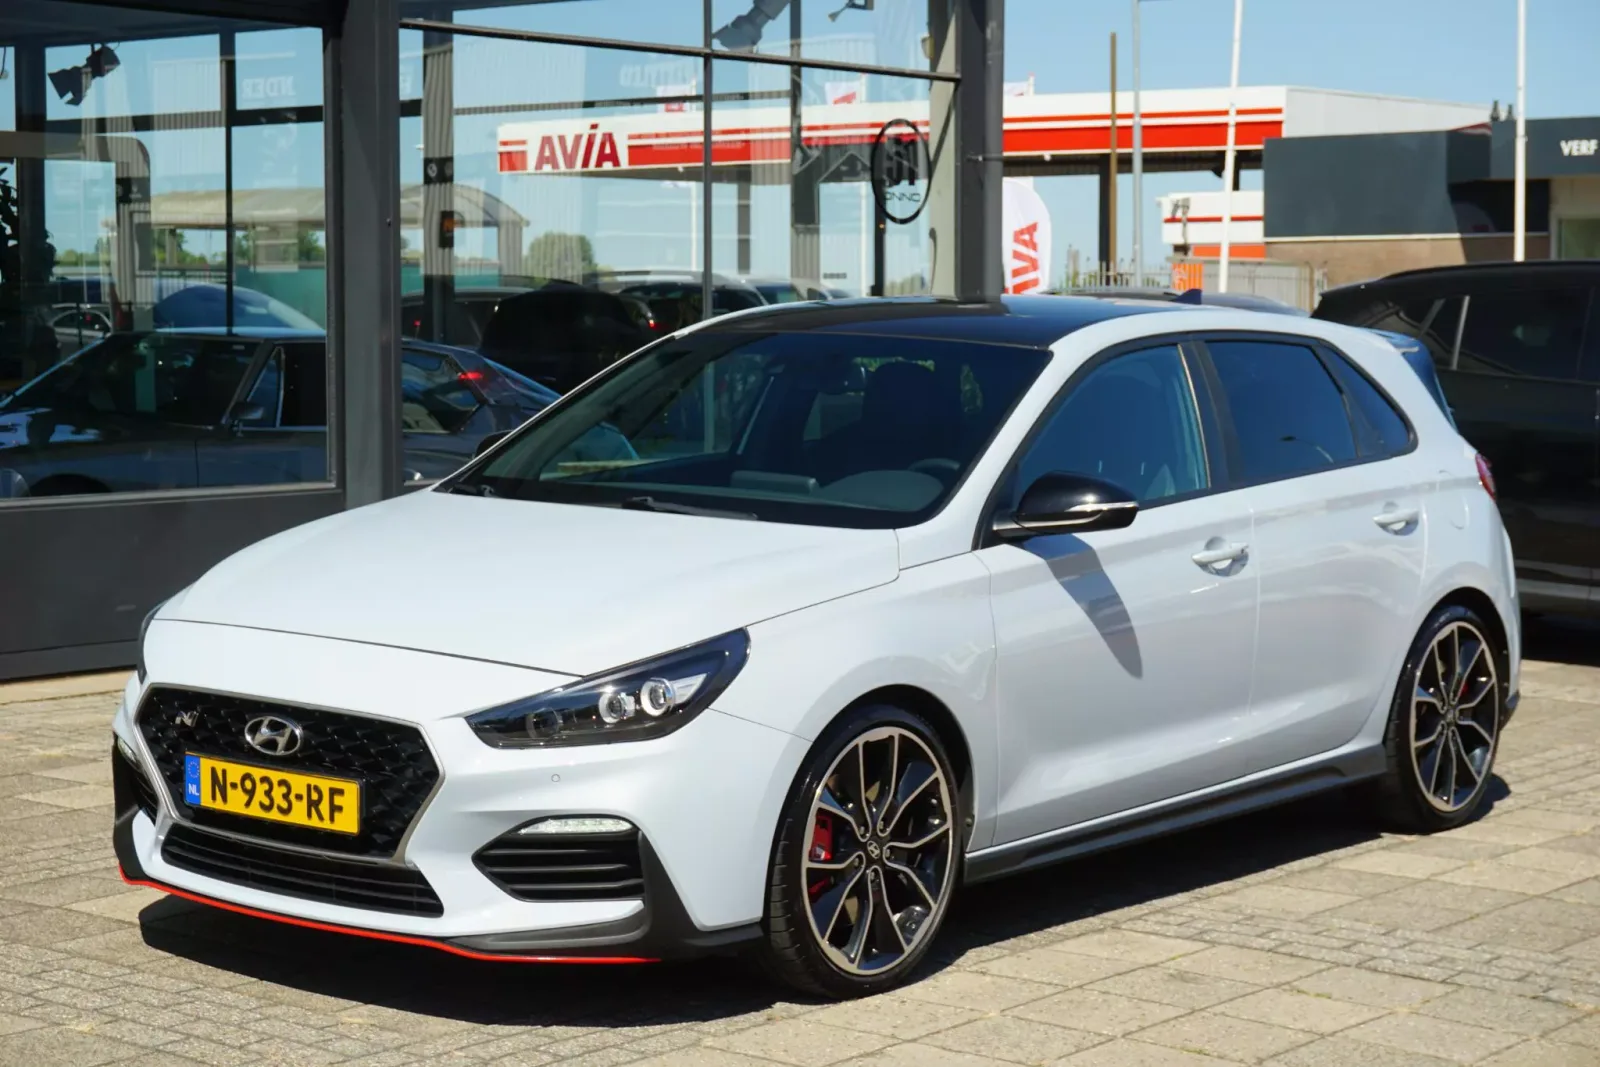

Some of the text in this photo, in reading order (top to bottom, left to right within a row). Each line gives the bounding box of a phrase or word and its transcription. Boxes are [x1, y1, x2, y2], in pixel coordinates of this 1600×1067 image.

[1560, 139, 1598, 156] VERF
[188, 783, 200, 796] NL
[210, 766, 345, 824] N-933-RF
